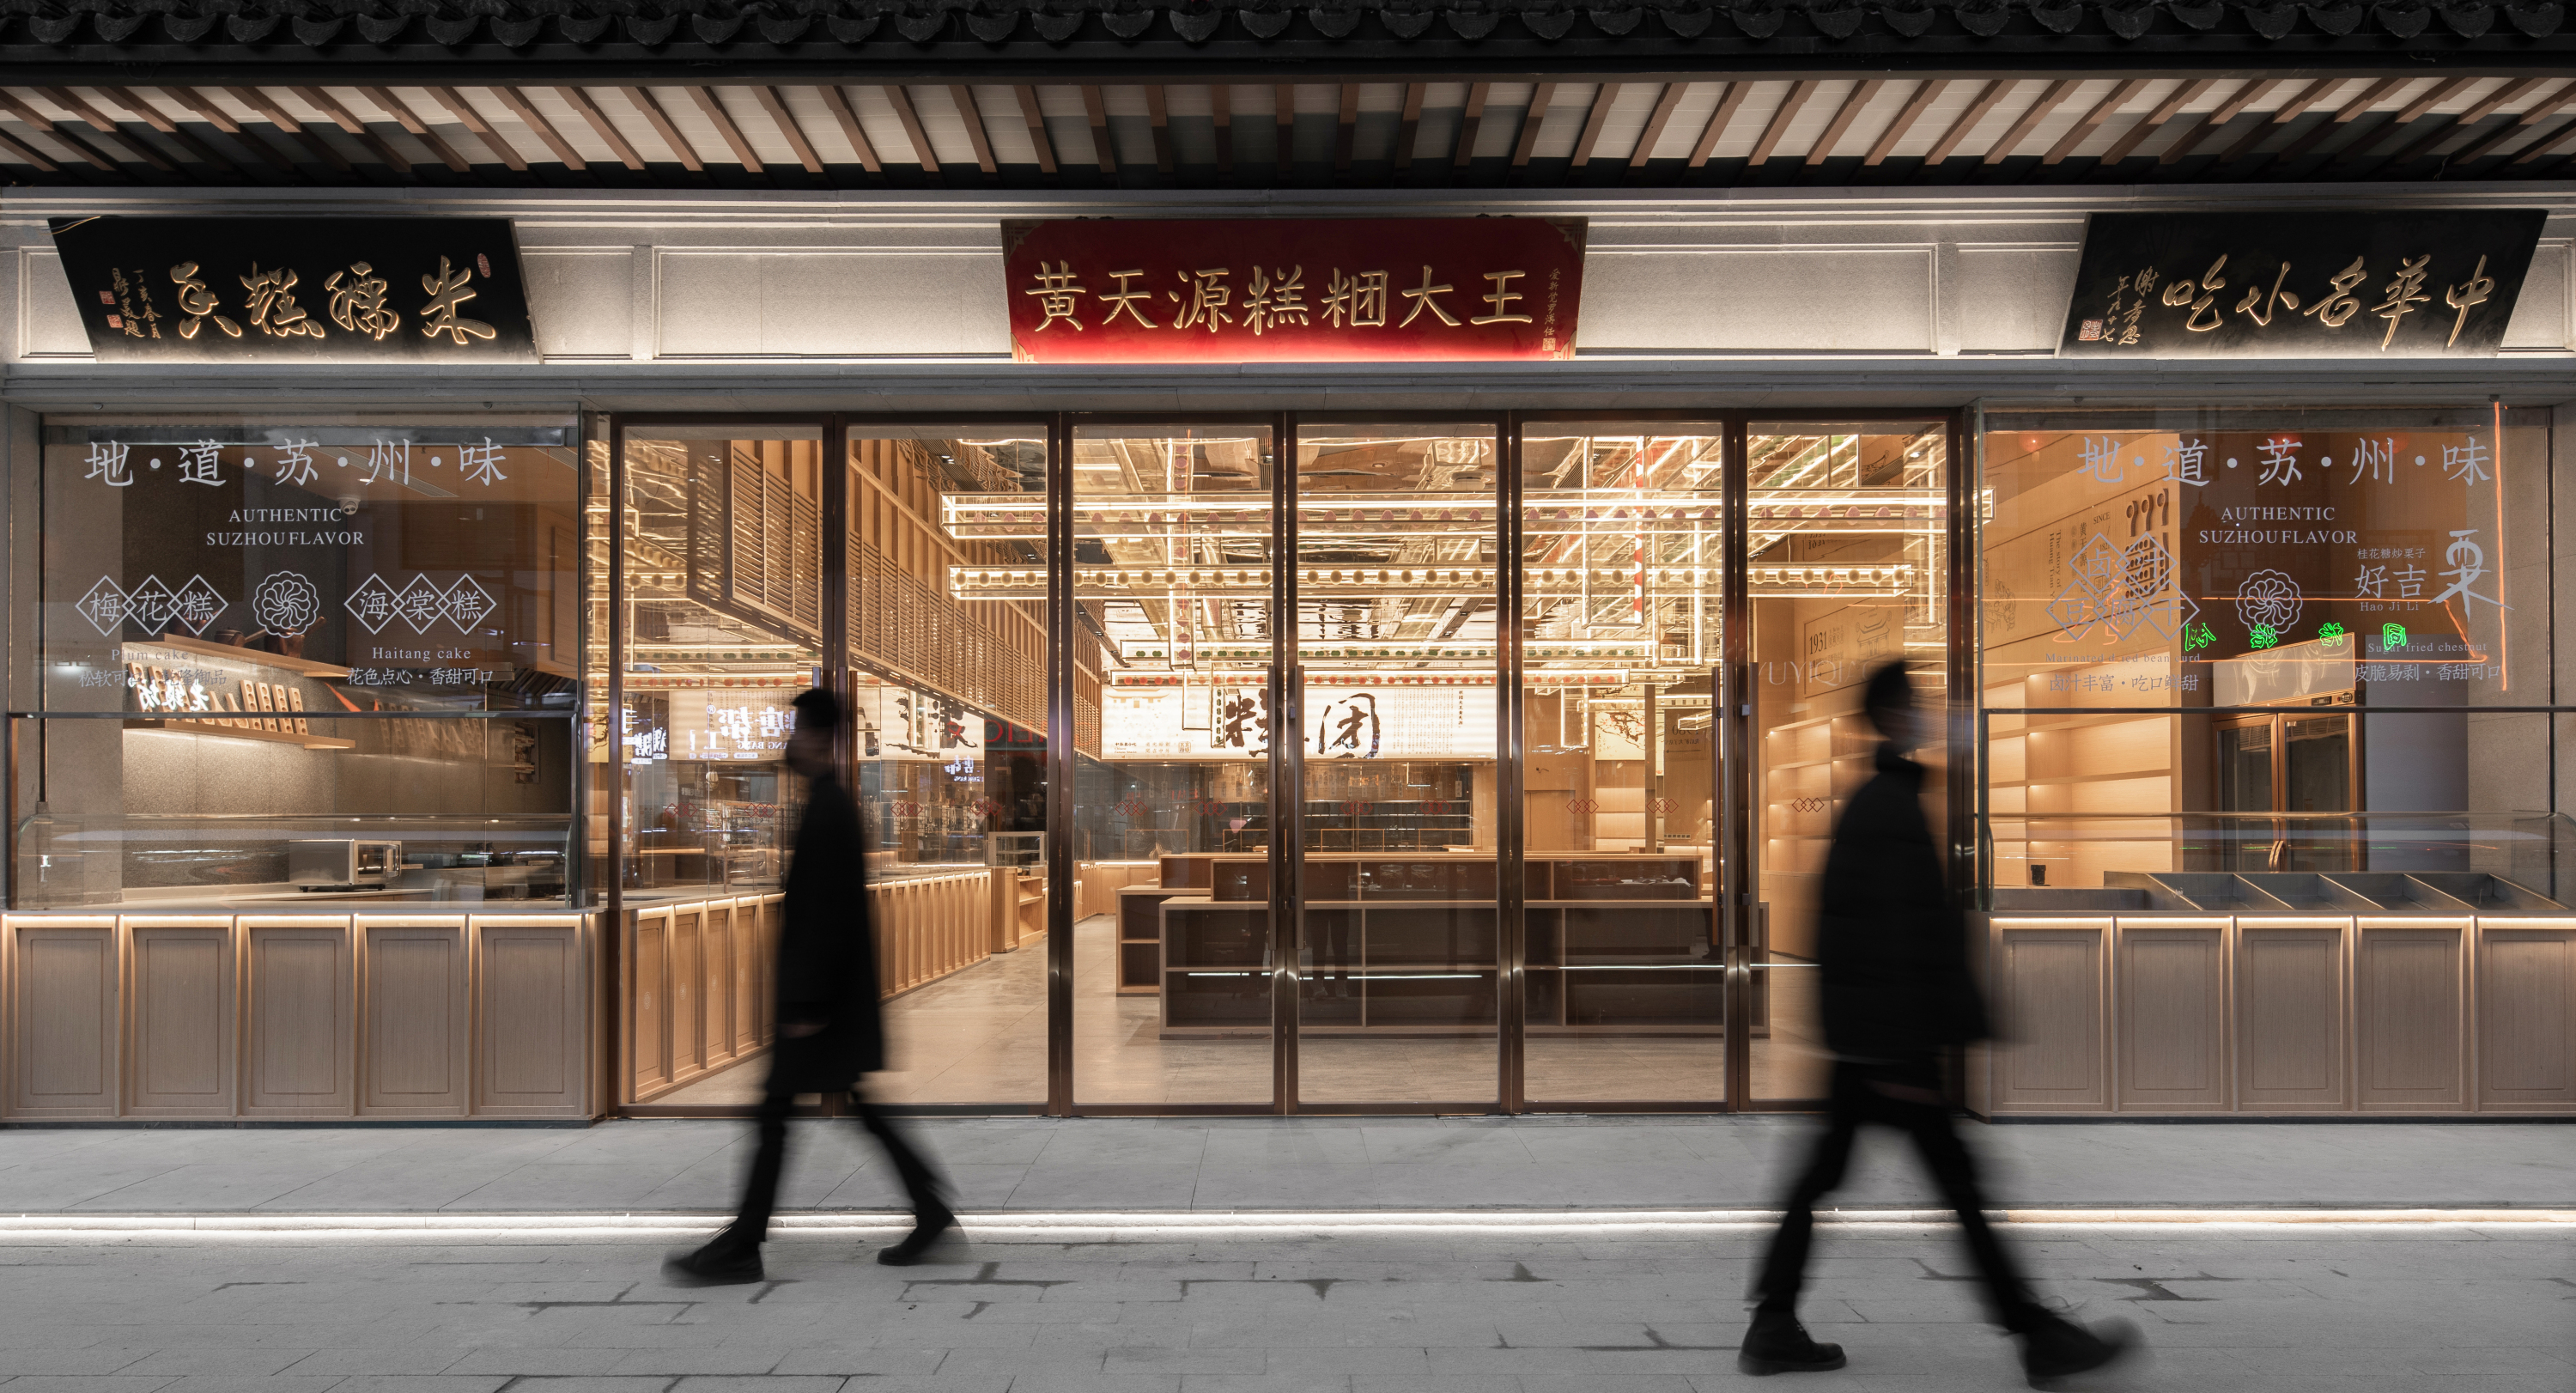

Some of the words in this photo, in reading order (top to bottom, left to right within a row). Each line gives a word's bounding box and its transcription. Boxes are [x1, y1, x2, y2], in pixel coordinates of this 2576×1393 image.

[228, 508, 343, 523] AUTHENTIC
[2221, 507, 2336, 520] AUTHENTIC
[2086, 547, 2166, 579] 卤汁
[89, 590, 216, 624] 梅花糕
[358, 588, 482, 623] 海棠糕
[2360, 602, 2383, 611] Hao
[2389, 602, 2401, 611] Ji
[2407, 602, 2419, 611] Li
[1808, 630, 1827, 655] 1931
[2367, 643, 2401, 655] Sugar
[2406, 643, 2433, 653] fried
[2439, 643, 2488, 653] chestnut
[111, 648, 149, 661] Plum
[155, 648, 189, 660] cake
[372, 648, 431, 660] Haitang
[438, 647, 471, 659] cake
[2045, 653, 2104, 663] Marinated
[2143, 653, 2170, 663] bean
